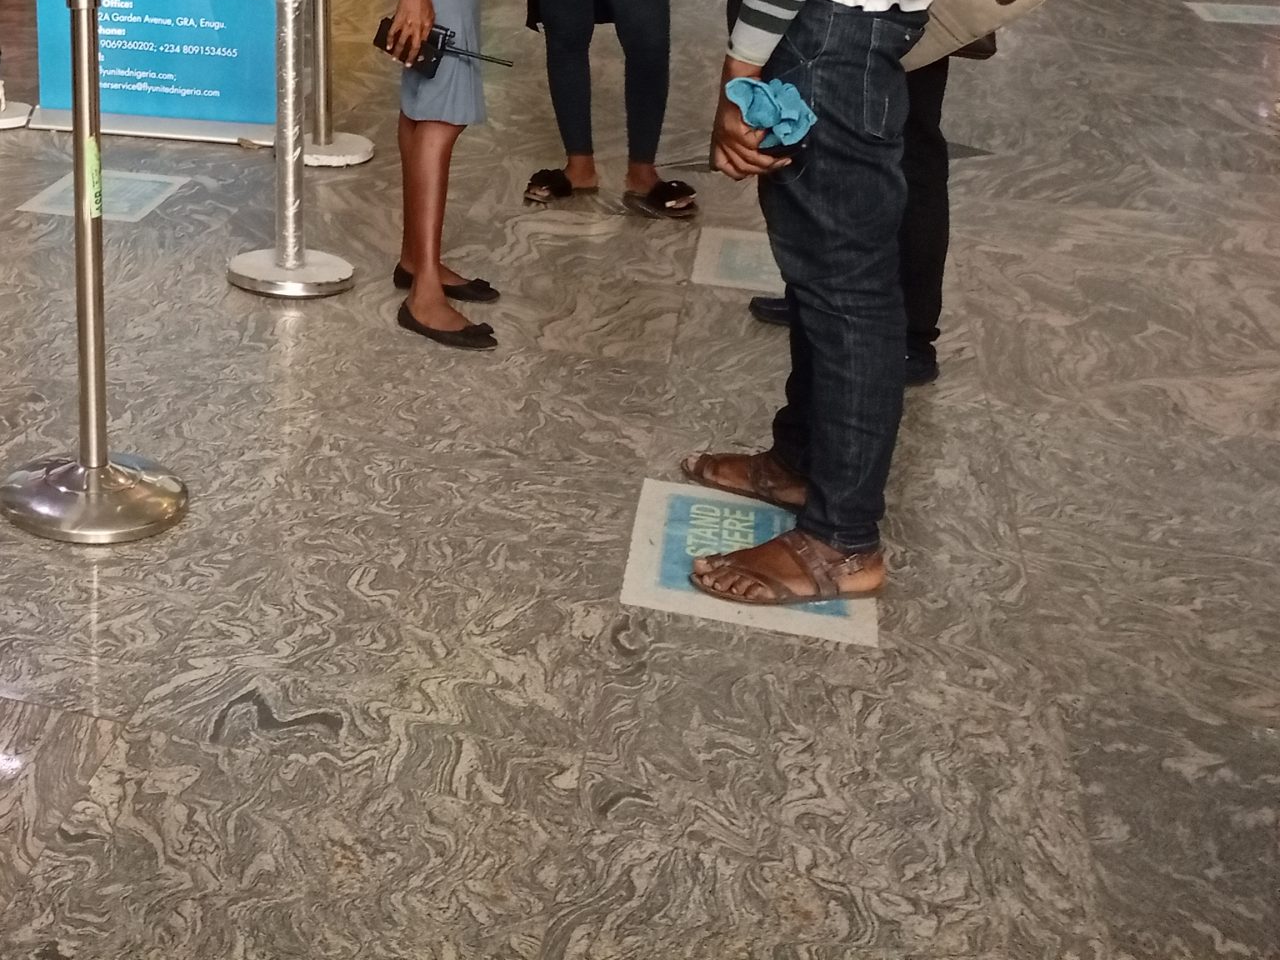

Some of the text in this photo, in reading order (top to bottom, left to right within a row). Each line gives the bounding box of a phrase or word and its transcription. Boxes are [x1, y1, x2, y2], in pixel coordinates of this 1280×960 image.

[111, 12, 142, 22] Garden
[143, 14, 175, 27] Avenue,
[176, 16, 197, 28] GRA,
[199, 17, 227, 30] Enugu.
[98, 25, 126, 36] hone:
[158, 43, 181, 53] +234
[182, 44, 238, 58] 8091534565
[99, 81, 220, 97] erservice@flyunitednigeria.com
[685, 503, 720, 557] STAND
